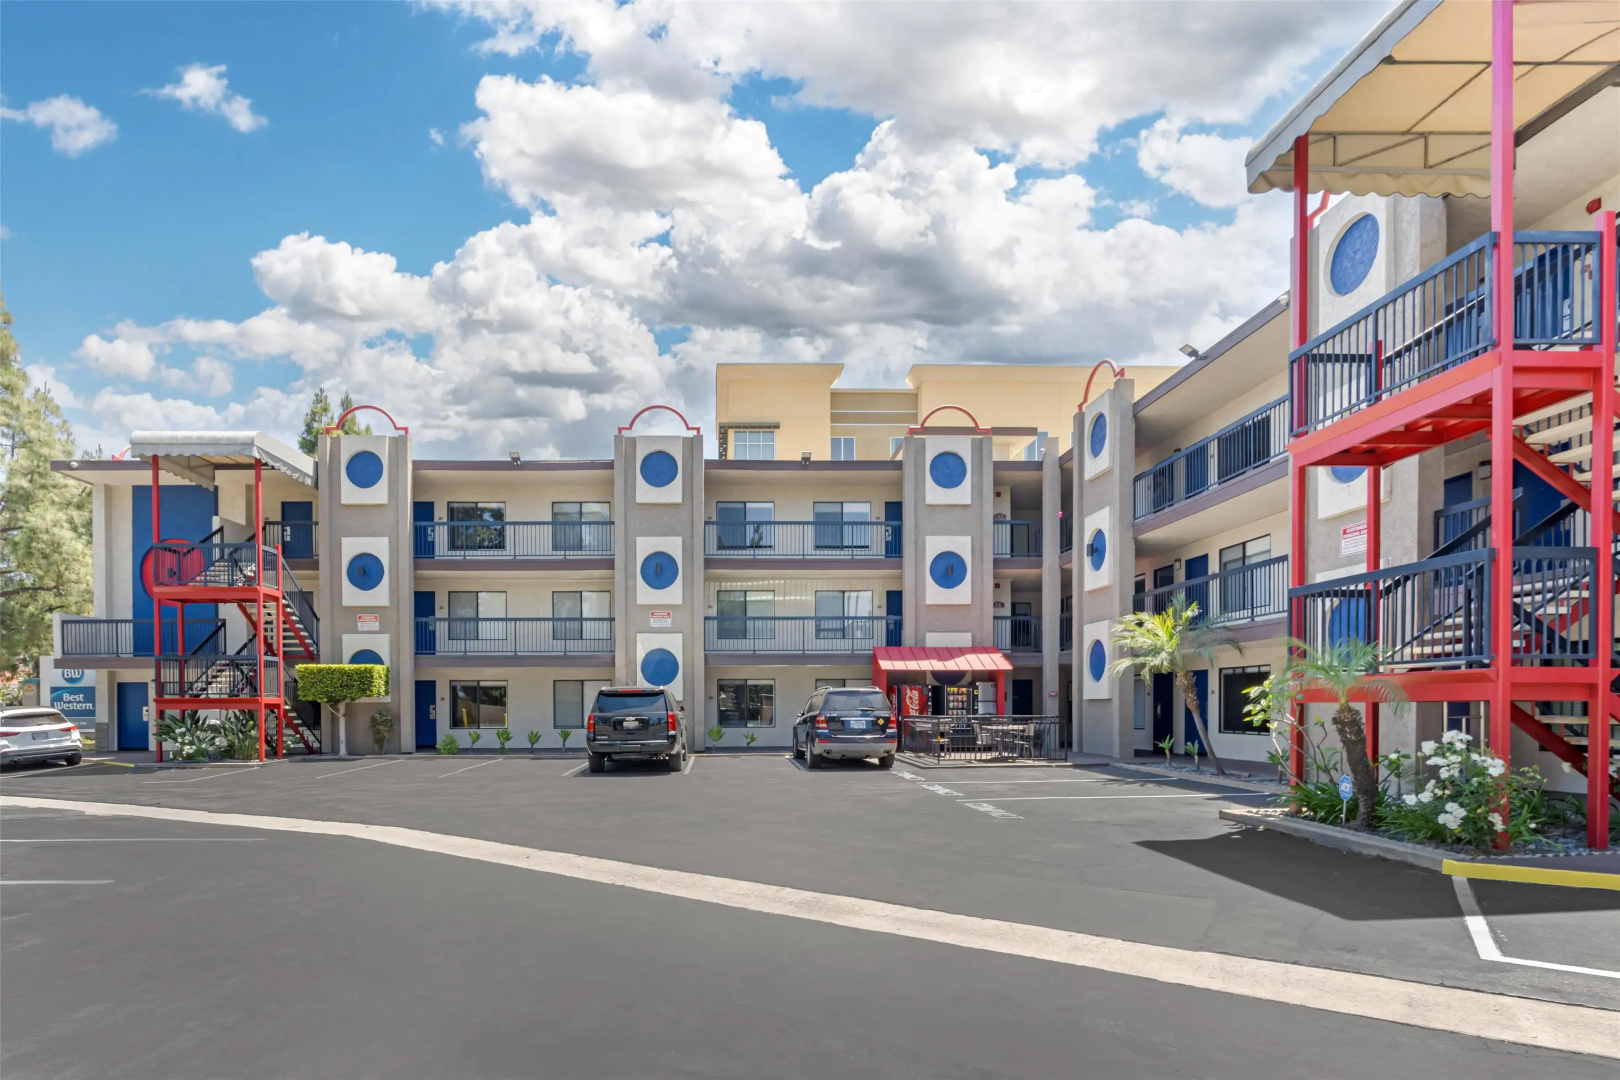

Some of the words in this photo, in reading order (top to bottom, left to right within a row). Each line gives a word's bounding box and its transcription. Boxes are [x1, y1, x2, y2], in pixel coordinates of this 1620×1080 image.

[64, 669, 81, 678] BW
[63, 693, 84, 701] Best
[54, 702, 93, 710] Western
